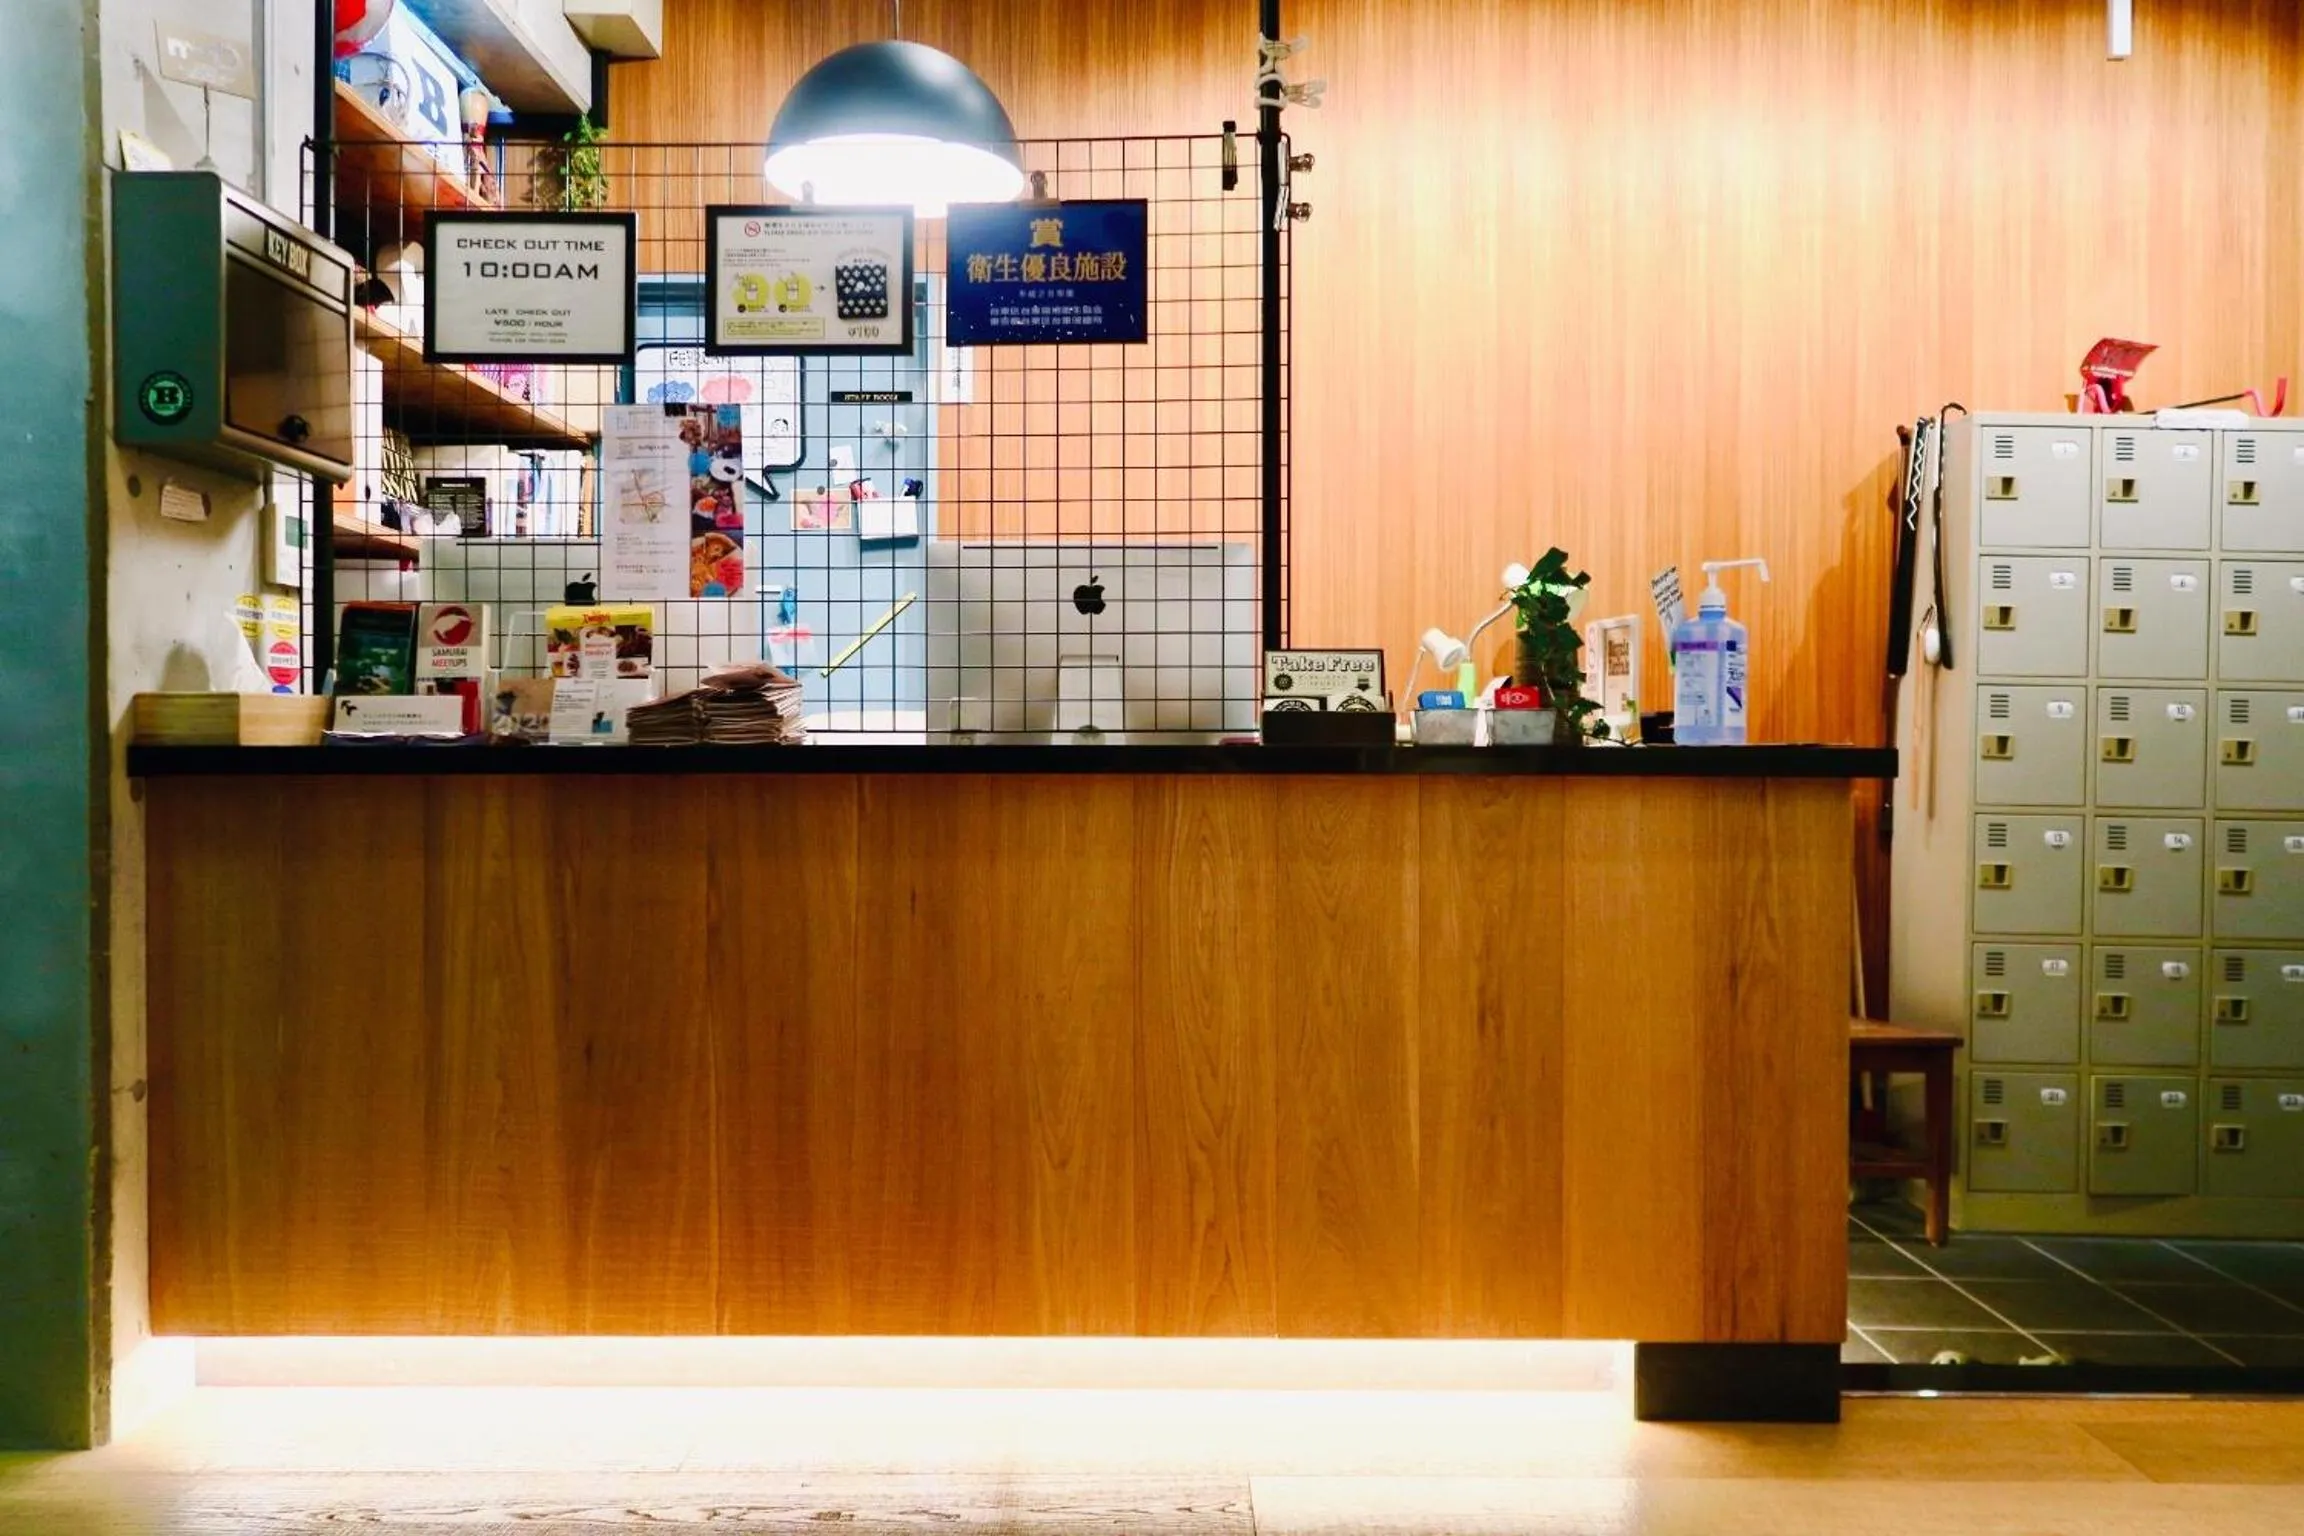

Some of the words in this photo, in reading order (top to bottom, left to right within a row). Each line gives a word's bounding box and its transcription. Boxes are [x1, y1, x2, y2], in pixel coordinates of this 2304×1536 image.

[412, 55, 448, 137] B
[1030, 218, 1063, 248] 賞
[268, 229, 288, 265] KEY
[287, 240, 308, 276] BOX
[457, 238, 517, 250] CHECK
[524, 240, 560, 251] OUT
[564, 240, 605, 251] TIME
[463, 261, 599, 280] 10:00AM
[967, 252, 1127, 283] 衛生優良施設
[432, 648, 468, 657] SAMURAI
[432, 658, 468, 668] MEETUPS
[1272, 655, 1325, 672] Take
[1327, 656, 1375, 672] Free
[2176, 706, 2186, 715] 10
